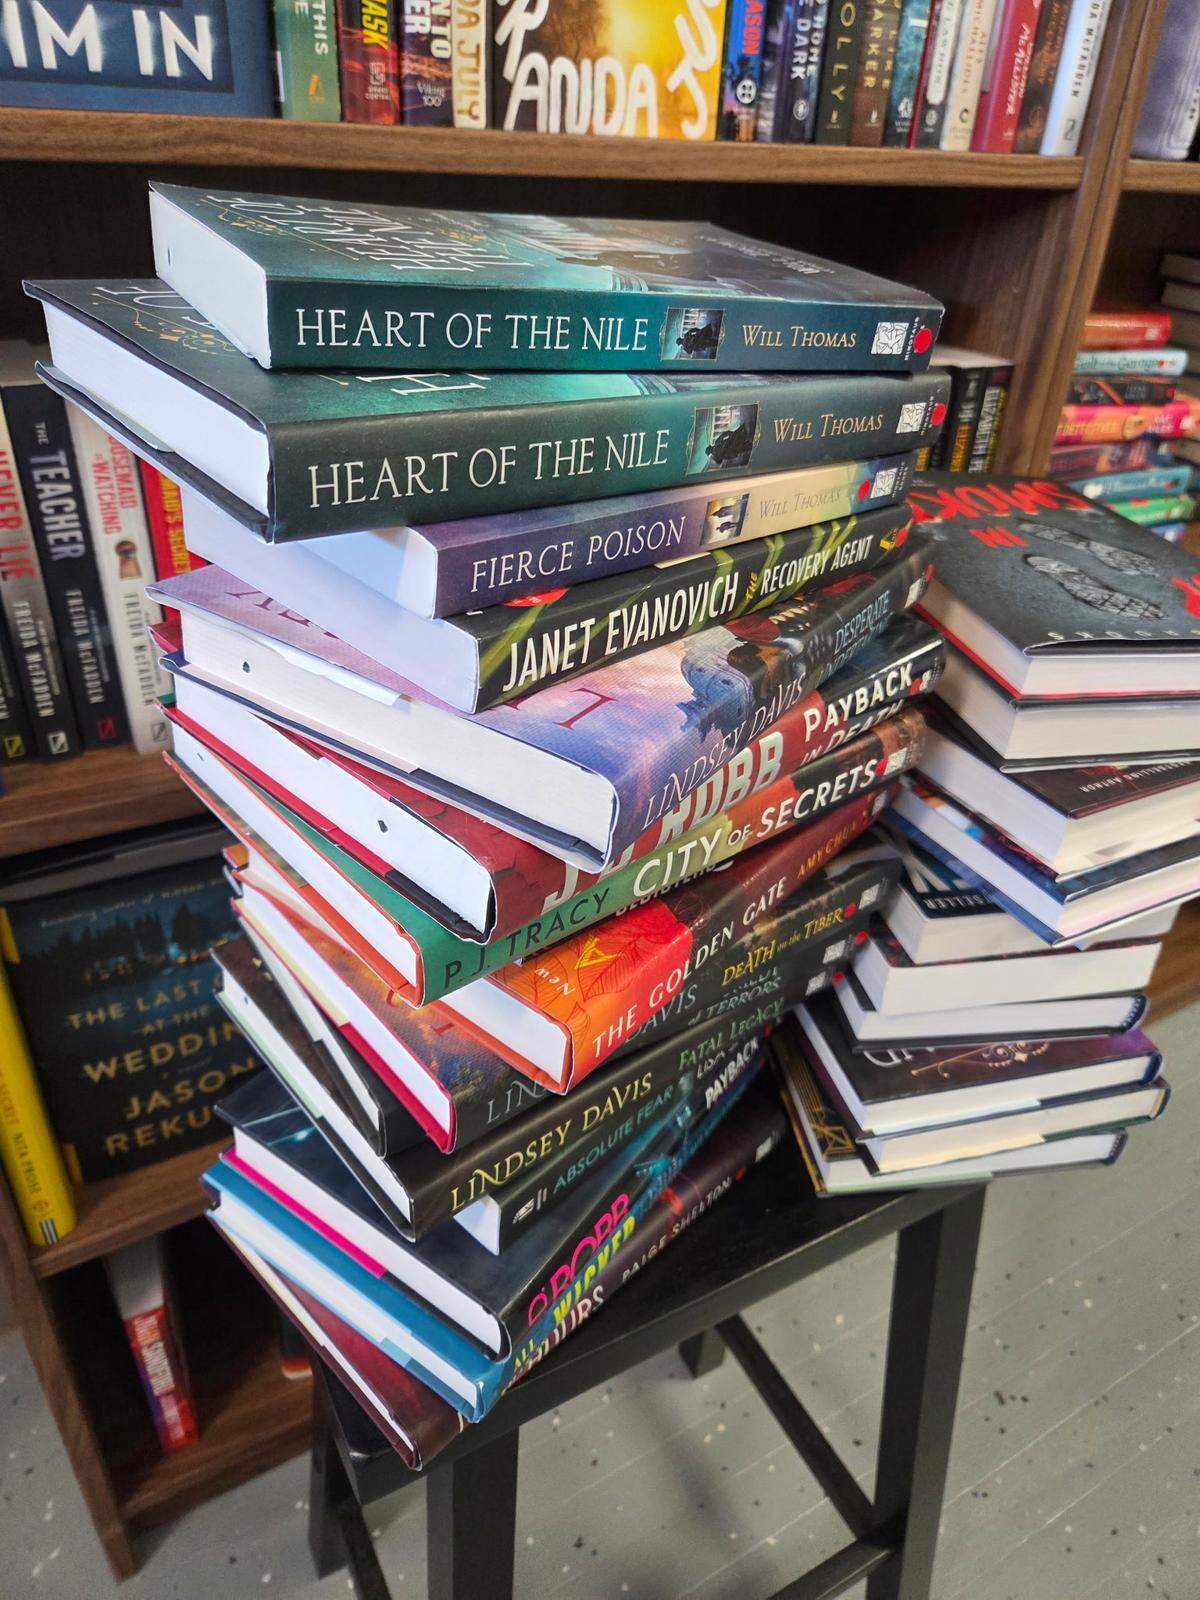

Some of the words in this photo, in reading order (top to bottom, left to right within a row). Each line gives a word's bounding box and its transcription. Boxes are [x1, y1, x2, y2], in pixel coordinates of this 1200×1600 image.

[132, 9, 213, 82] IN
[361, 0, 390, 50] ASK
[791, 18, 812, 80] DARK
[864, 0, 884, 88] ARKER
[457, 39, 481, 121] JULY
[296, 308, 434, 349] HEART
[446, 312, 492, 349] OF
[505, 314, 571, 350] THE
[581, 316, 649, 352] NILE
[29, 450, 86, 562] TEACHER
[95, 461, 122, 535] WATCHING
[308, 451, 459, 509] HEART
[468, 445, 517, 489] OF
[529, 437, 595, 482] THE
[604, 429, 670, 472] NILE
[470, 540, 574, 593] FIERCE
[586, 515, 688, 566] POISON
[760, 549, 830, 597] RECOVERY
[830, 535, 875, 572] AGENT
[502, 617, 596, 693] JANET
[604, 571, 739, 656] EVANOVICH
[803, 662, 913, 743] PAYBACK
[642, 718, 748, 831] LINDSEY
[749, 671, 807, 740] DAVIS
[632, 828, 723, 898] CITY
[728, 823, 753, 846] OF
[757, 758, 877, 837] SECRETS
[506, 887, 611, 957] TRACY
[592, 1003, 637, 1058] THE
[648, 922, 735, 1009] GOLDEN
[742, 875, 788, 927] GATE
[722, 939, 777, 986] DEATH
[66, 1002, 127, 1031] THE
[136, 980, 200, 1013] LAST
[83, 1021, 243, 1084] WEDDIN
[126, 1057, 256, 1120] JASON
[705, 1037, 759, 1110] PAYBACK
[104, 1106, 212, 1159] REKU
[451, 1119, 572, 1212] LINDSEY
[582, 1071, 653, 1132] DAVIS
[553, 1118, 634, 1194] ABSOLUTE
